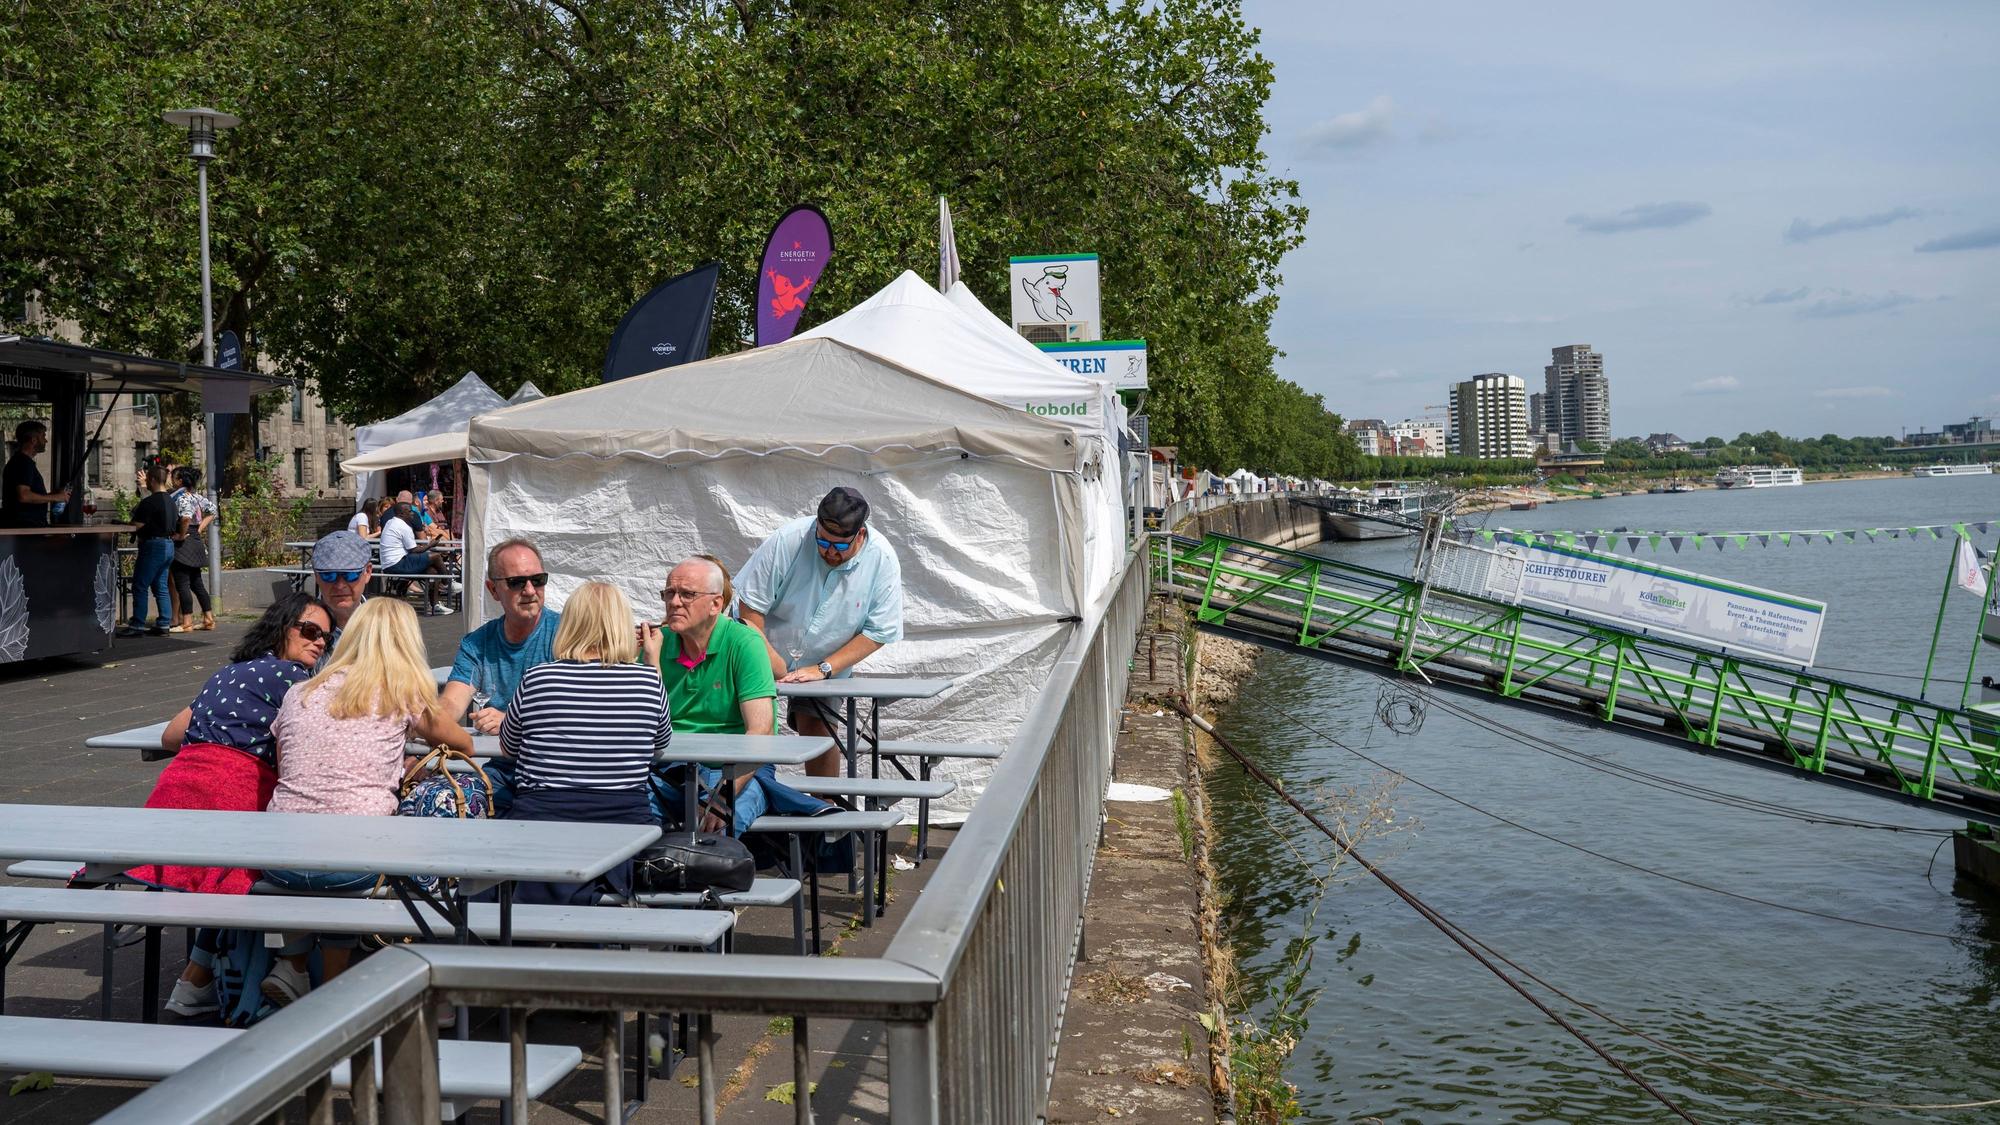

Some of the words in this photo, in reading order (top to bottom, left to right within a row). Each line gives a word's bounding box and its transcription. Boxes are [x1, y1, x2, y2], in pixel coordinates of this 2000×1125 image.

[780, 250, 816, 258] ENERGETIX
[1026, 402, 1087, 415] kobold
[1525, 564, 1607, 583] SCHIFFSTOUREN
[1639, 591, 1686, 608] KölnTourist
[1727, 601, 1760, 613] Panorama-
[1768, 611, 1808, 625] Hafentouren
[1727, 610, 1748, 620] Event-
[1755, 616, 1804, 632] Themenfahrten
[1740, 621, 1787, 638] Charterfahrten
